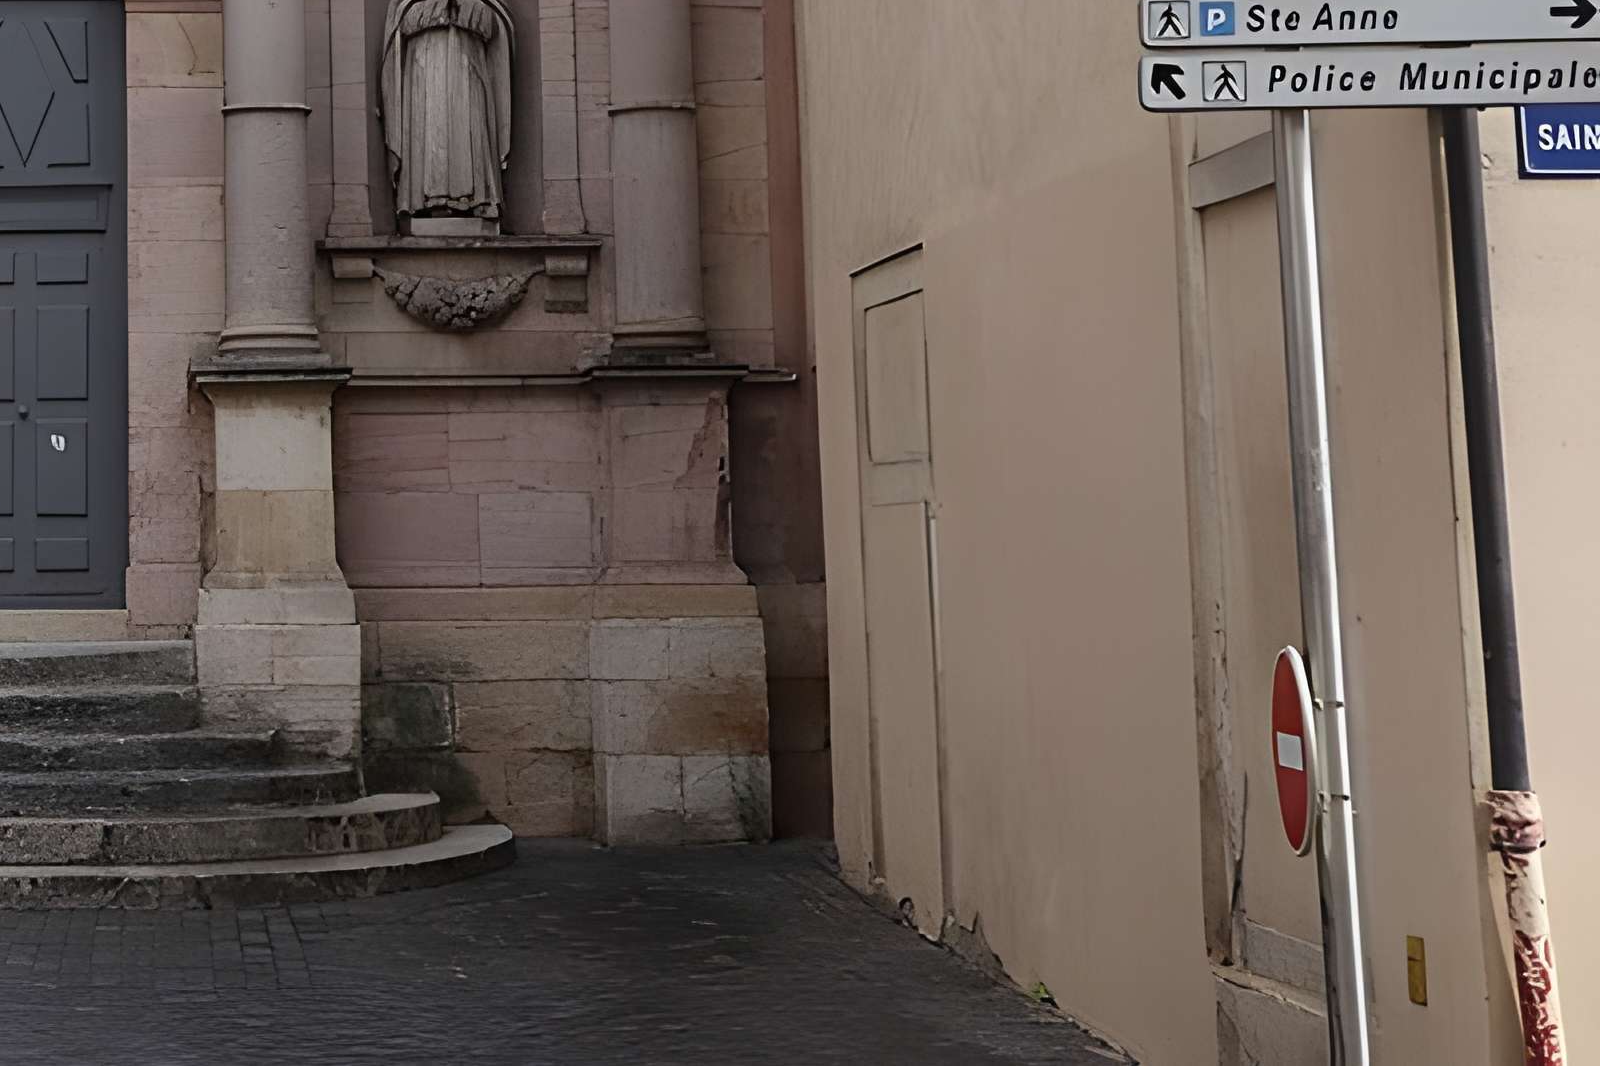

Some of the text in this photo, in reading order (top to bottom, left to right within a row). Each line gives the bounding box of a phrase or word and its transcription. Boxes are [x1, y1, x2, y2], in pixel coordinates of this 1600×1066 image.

[1246, 4, 1301, 33] Ste
[1312, 2, 1398, 31] Anne
[1268, 60, 1600, 95] Police Municipale
